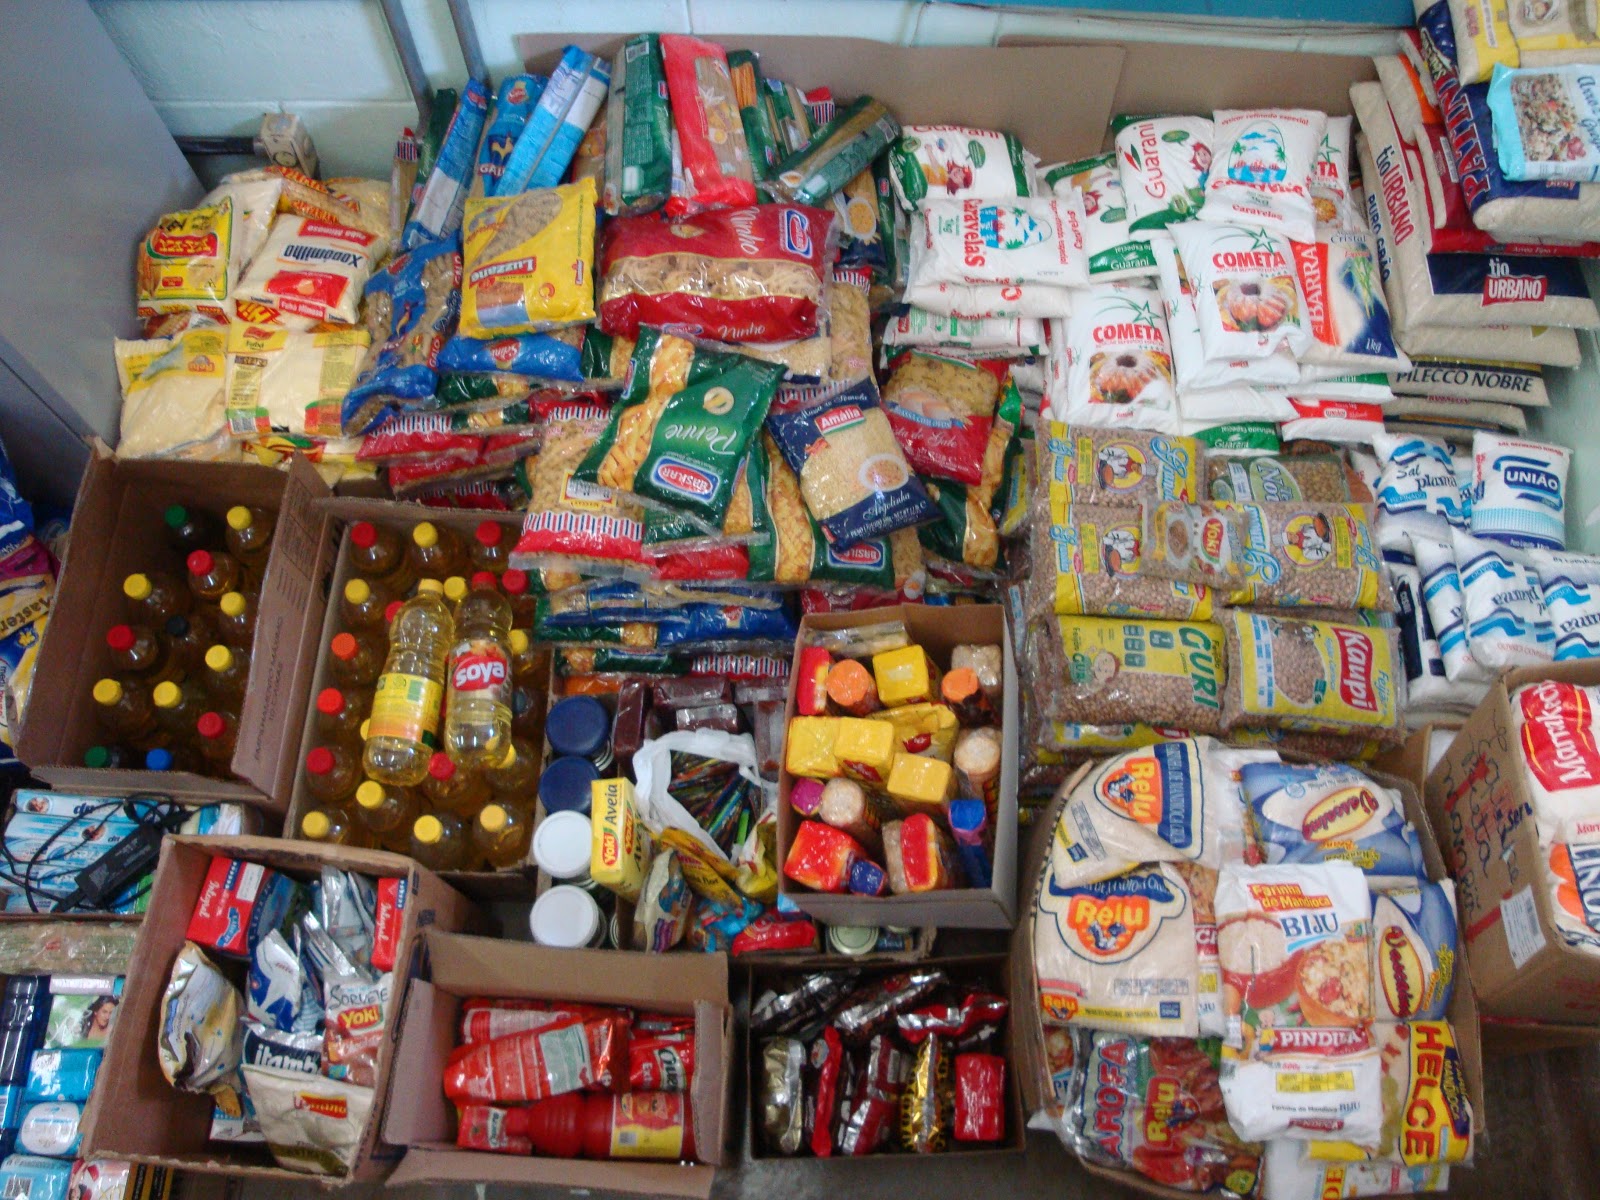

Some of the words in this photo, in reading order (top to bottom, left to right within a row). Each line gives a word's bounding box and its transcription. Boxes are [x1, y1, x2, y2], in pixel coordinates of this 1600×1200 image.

[1145, 123, 1166, 199] Guarani
[1110, 256, 1149, 271] Guarani
[1212, 251, 1286, 268] COMETA
[1489, 258, 1510, 275] tio
[1488, 279, 1541, 299] URBANO
[1092, 323, 1164, 342] COMETA
[1472, 373, 1533, 392] NOBRE
[820, 407, 862, 433] Amália
[664, 423, 737, 457] Penne
[1214, 438, 1249, 449] Guarani
[658, 464, 716, 494] BASILAR
[1397, 466, 1421, 479] Sal
[1506, 470, 1558, 490] UNIÃO
[1206, 522, 1221, 553] Yoki
[456, 660, 505, 686] soya
[1177, 626, 1219, 710] GURI
[1340, 629, 1377, 711] Kaupi
[1130, 761, 1155, 819] Relu
[604, 784, 618, 825] Aveia
[603, 833, 618, 866] Yoki
[1252, 884, 1301, 897] Farinha
[1263, 898, 1278, 908] de
[1282, 895, 1331, 909] Mandioca
[1076, 901, 1143, 926] Relu
[1280, 912, 1338, 938] BIJU
[329, 985, 389, 1010] SORVETE
[1043, 996, 1075, 1011] Relu
[342, 1008, 378, 1028] Yoki
[254, 1044, 318, 1074] itamb
[1100, 1041, 1130, 1158] AROFA
[1406, 1025, 1441, 1158] HELCE
[1147, 1081, 1179, 1142] Relu
